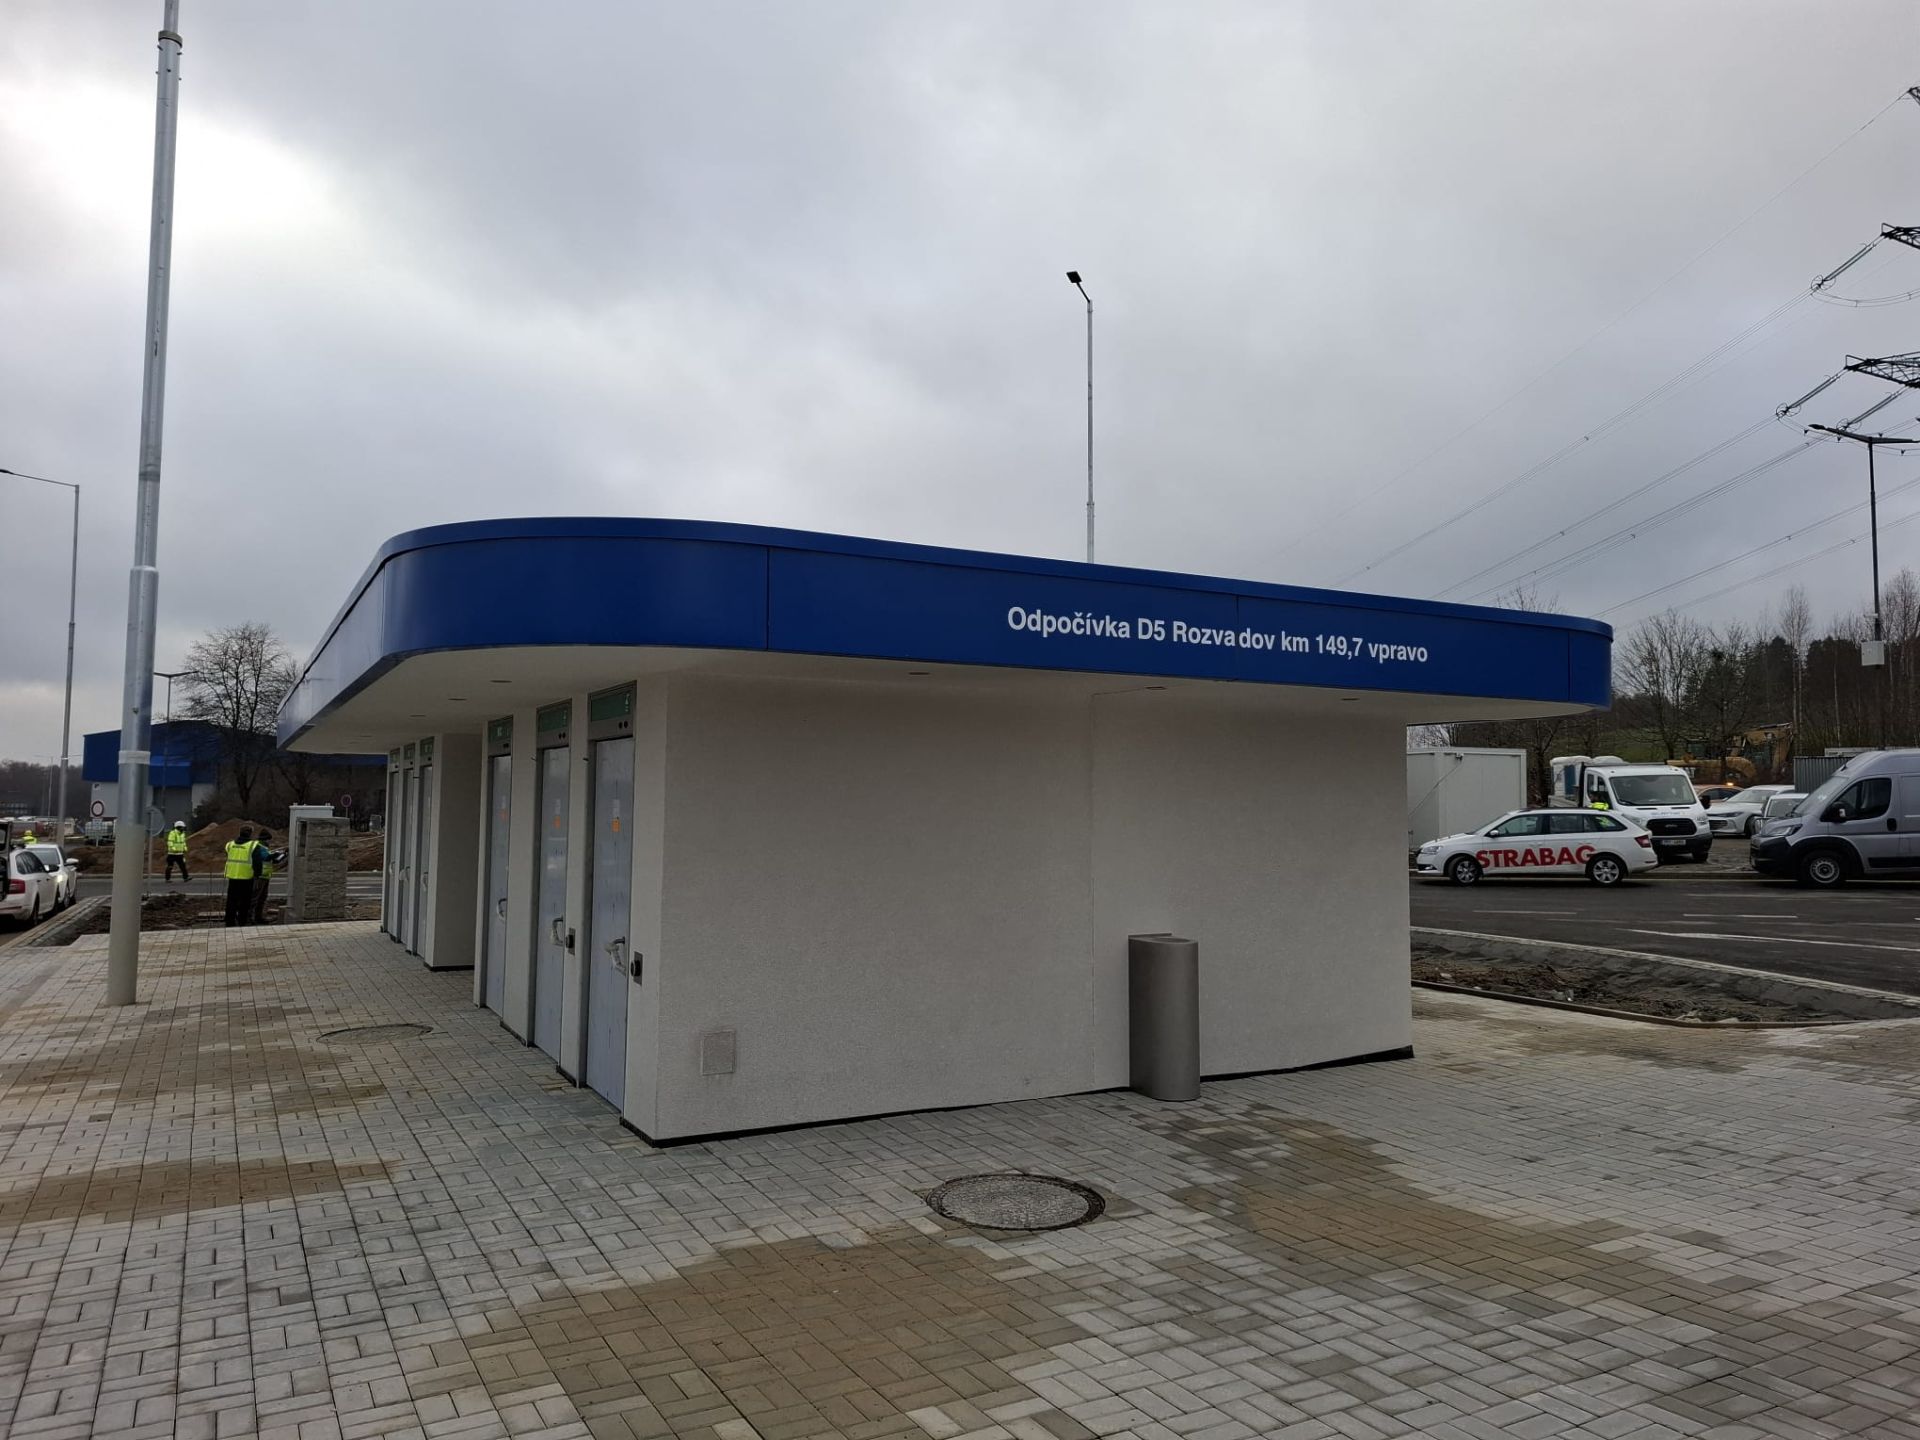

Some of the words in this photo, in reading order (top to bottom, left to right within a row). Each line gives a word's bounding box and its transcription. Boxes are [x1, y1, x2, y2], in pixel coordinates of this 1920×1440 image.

[1007, 606, 1131, 639] Odpočívka
[1137, 617, 1166, 641] D5
[1172, 620, 1275, 650] Rozvadov
[1281, 630, 1310, 653] km
[1315, 634, 1363, 660] 149,7
[1367, 643, 1428, 664] vpravo
[1475, 845, 1597, 869] STRABAG
